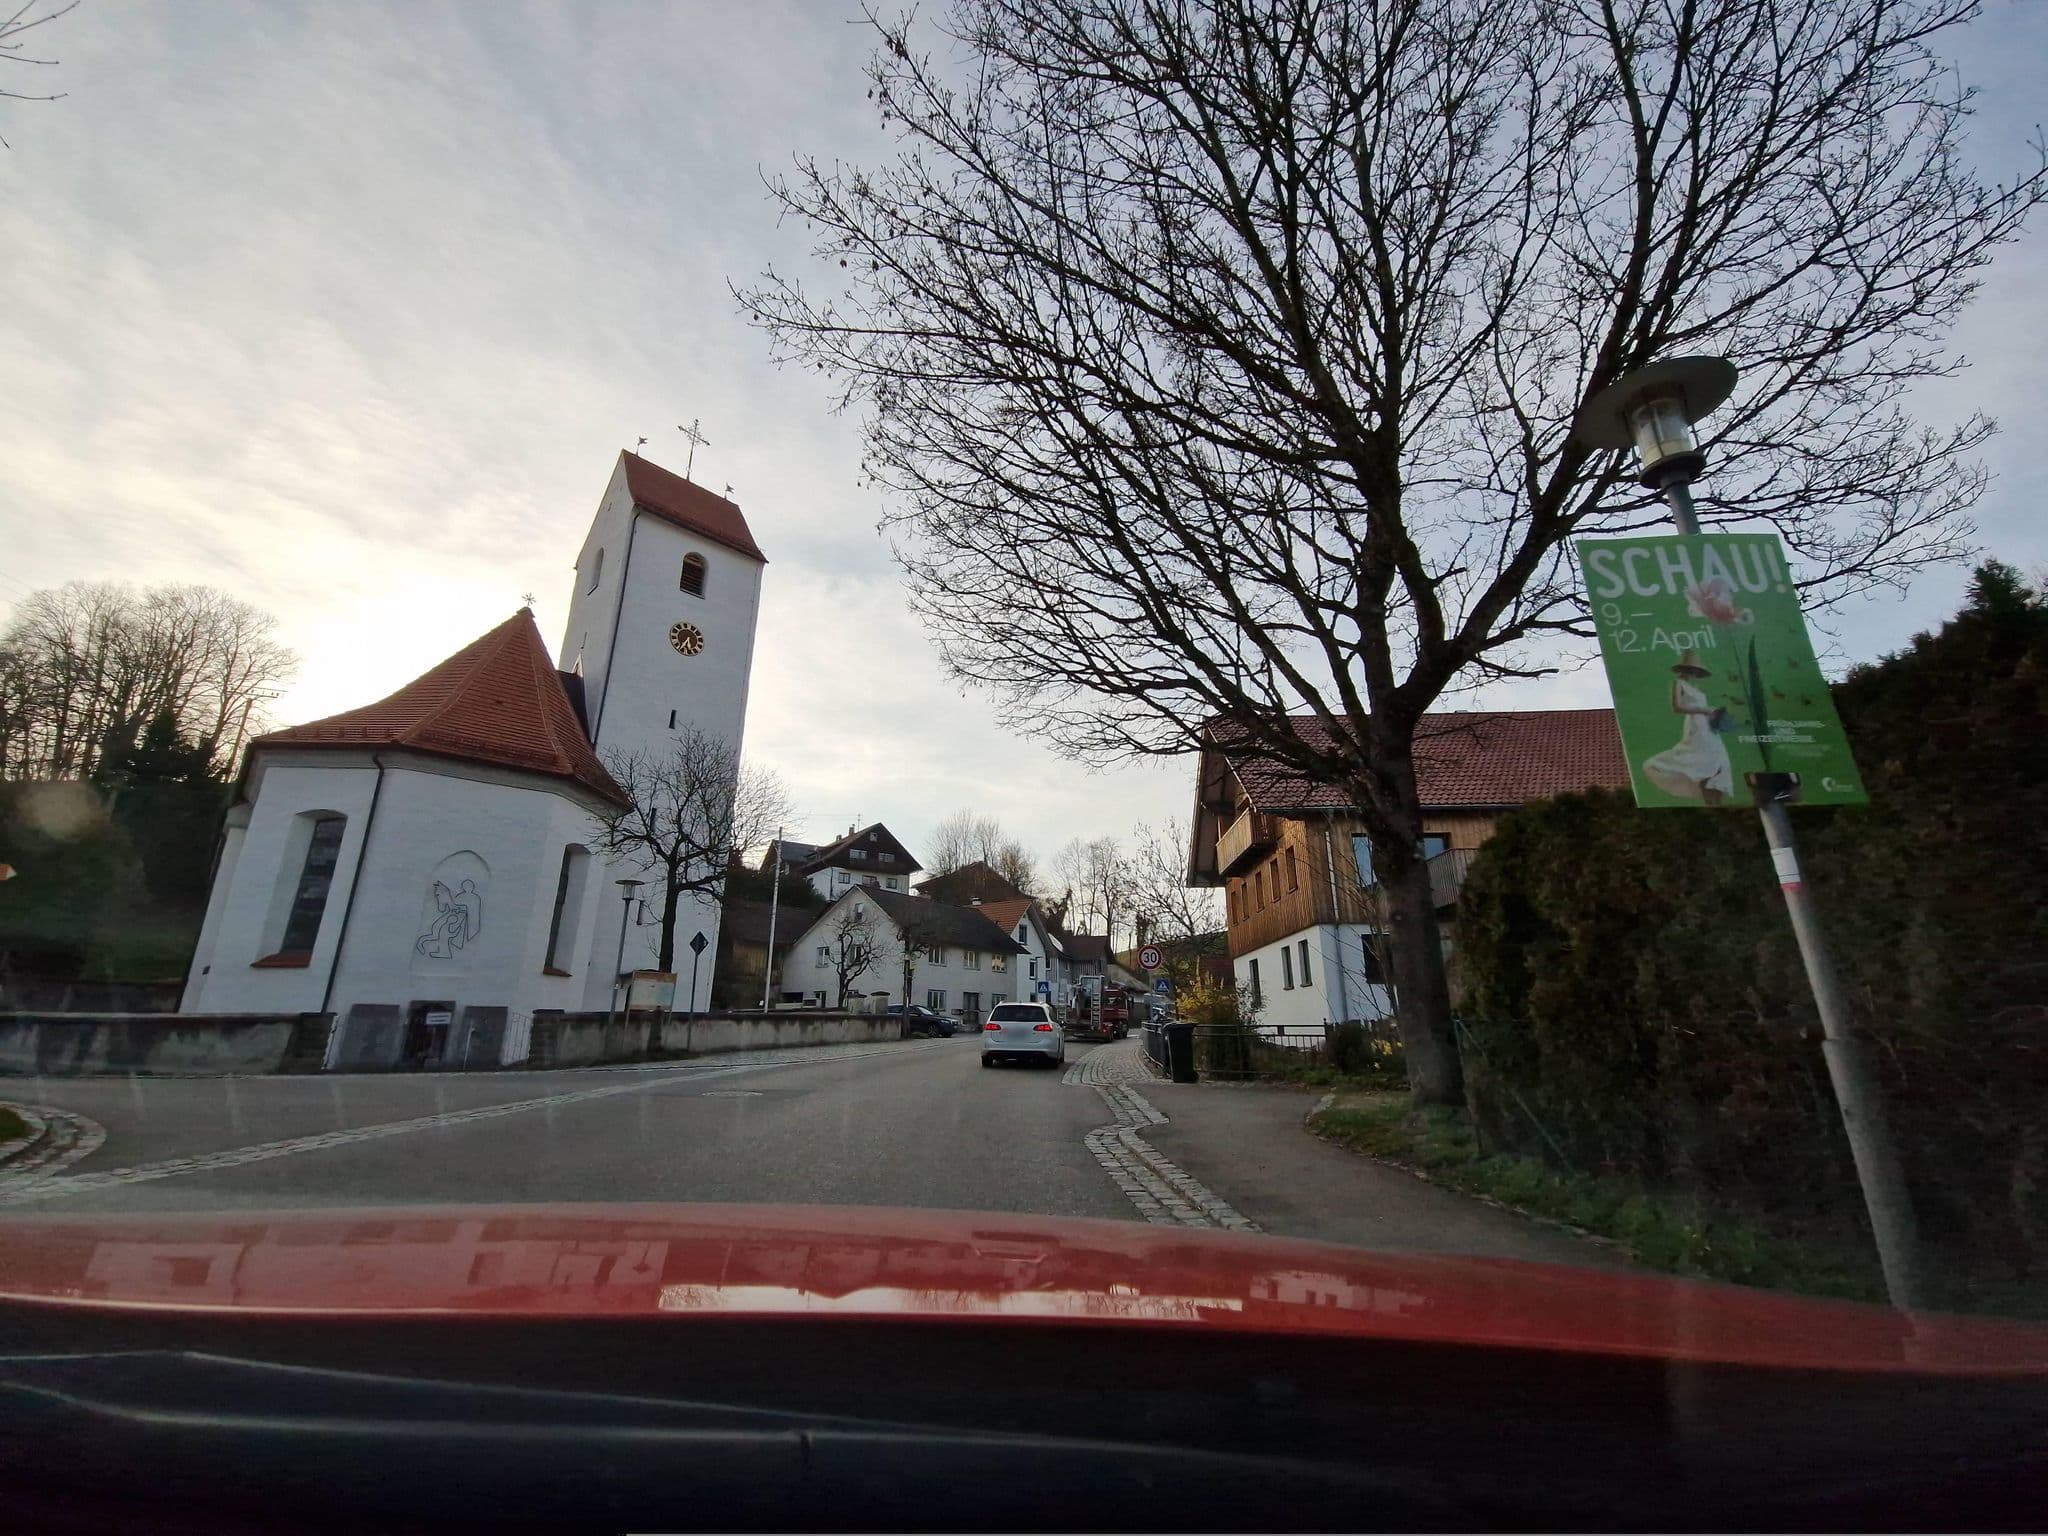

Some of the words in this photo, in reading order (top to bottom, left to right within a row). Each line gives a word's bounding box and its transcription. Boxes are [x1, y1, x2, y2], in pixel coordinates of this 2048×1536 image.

[1588, 543, 1787, 599] SCHAU!
[1608, 629, 1647, 653] 12.
[1650, 624, 1717, 656] April
[1143, 952, 1157, 963] 30
